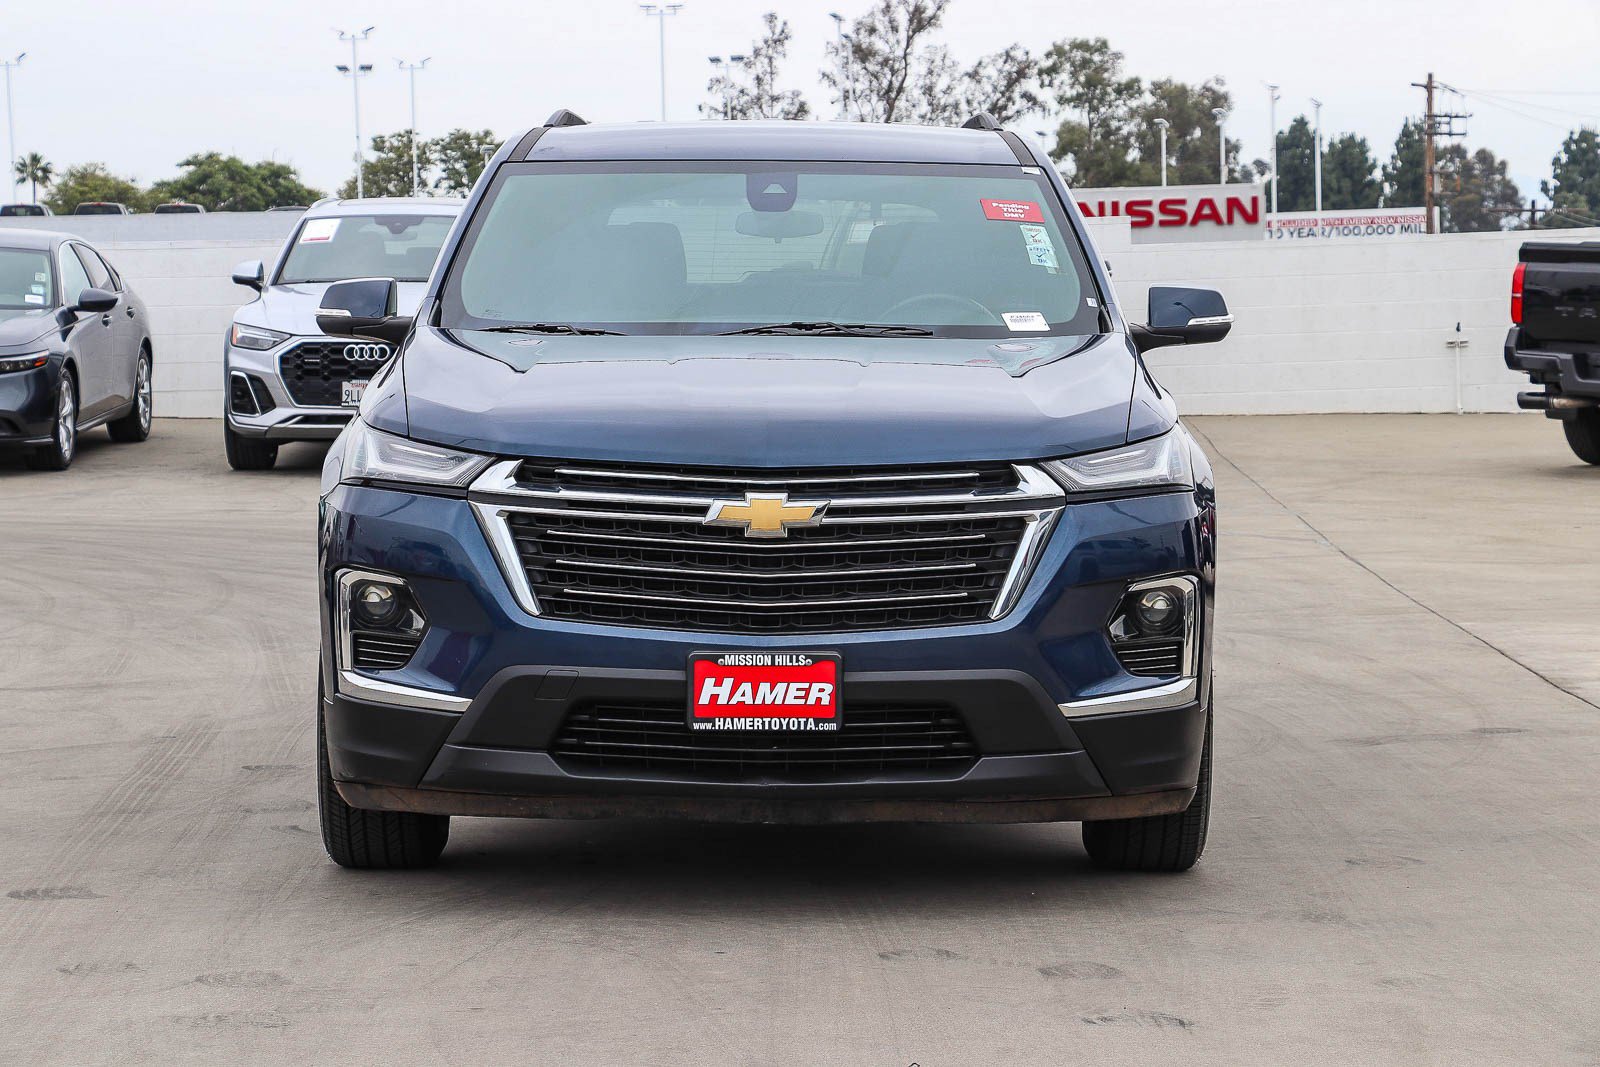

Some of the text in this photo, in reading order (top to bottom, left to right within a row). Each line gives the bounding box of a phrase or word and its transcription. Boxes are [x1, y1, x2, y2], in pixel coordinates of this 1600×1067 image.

[991, 202, 1030, 210] Pending
[1374, 216, 1396, 225] NEW
[1398, 214, 1428, 225] NISSA
[1400, 223, 1427, 234] MIL
[344, 389, 362, 402] 9LL
[725, 655, 806, 666] MISSION HILLS
[698, 677, 834, 706] HAMER
[693, 717, 837, 731] www.HAMERTOYOTA.com
